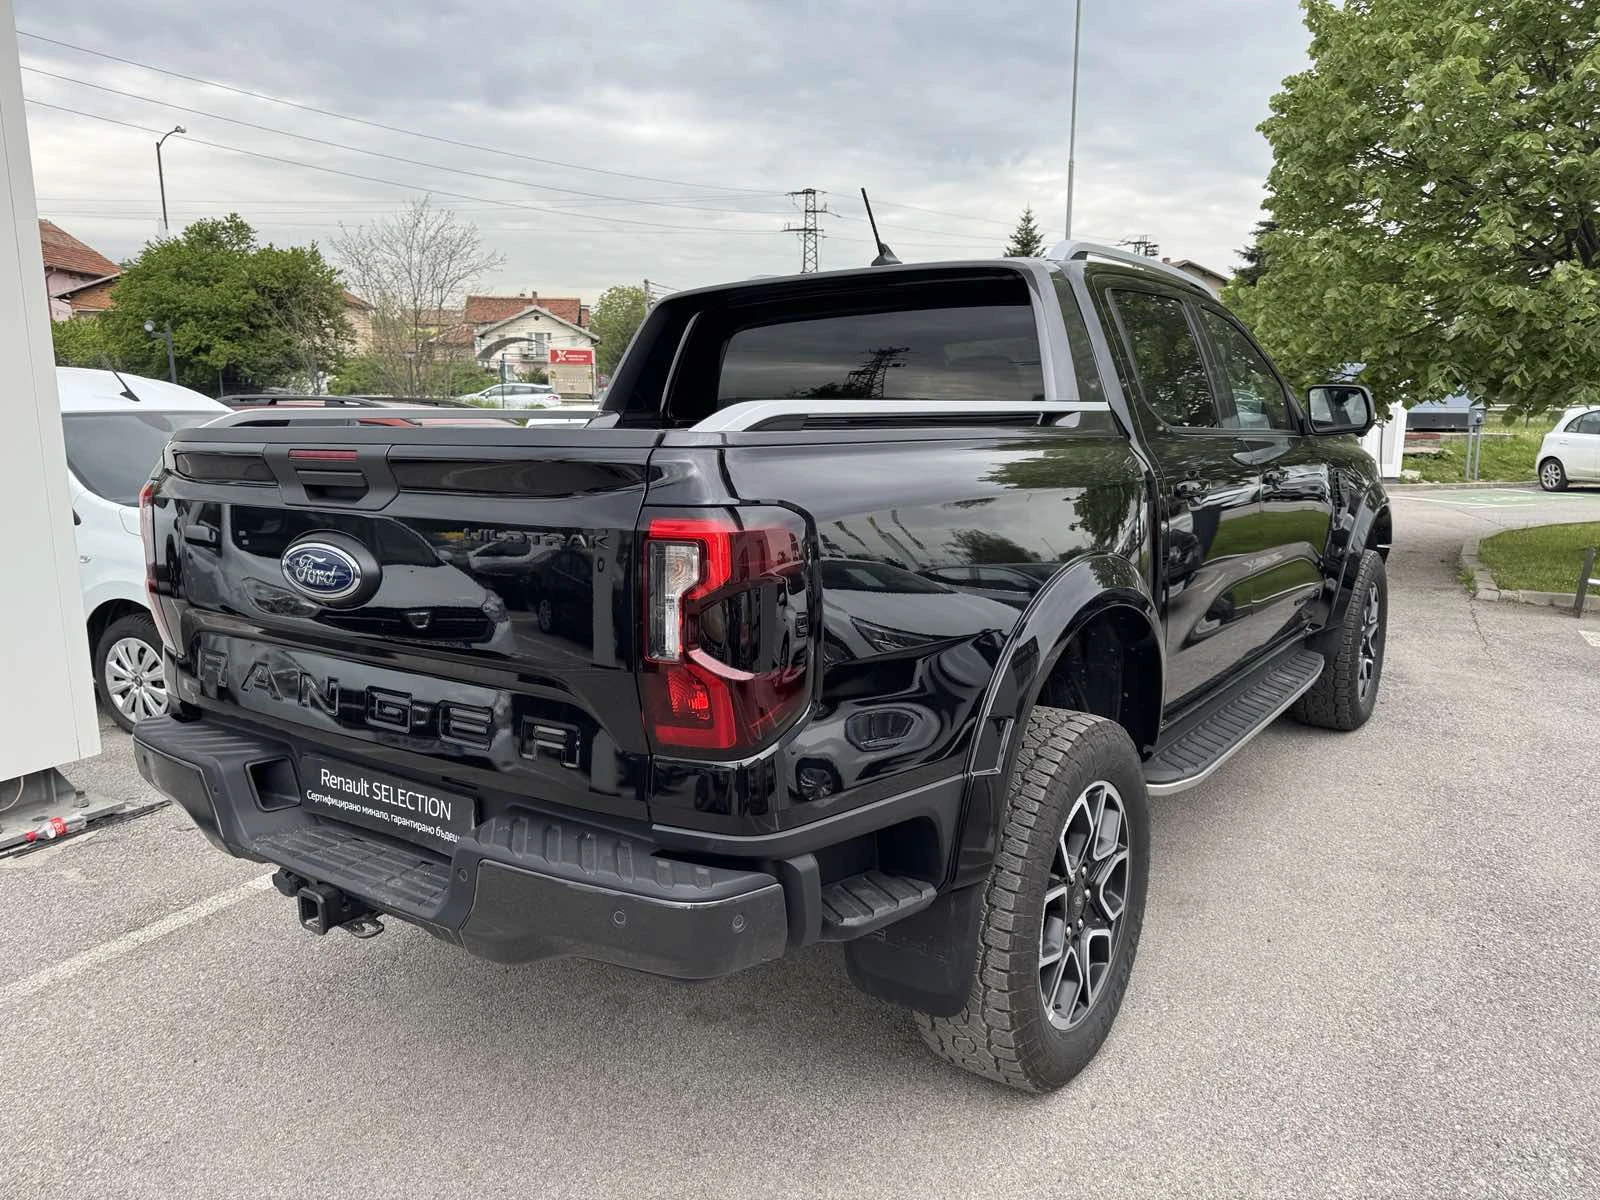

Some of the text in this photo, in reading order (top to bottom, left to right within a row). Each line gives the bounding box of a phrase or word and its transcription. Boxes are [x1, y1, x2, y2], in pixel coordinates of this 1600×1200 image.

[295, 554, 337, 586] Ford
[199, 650, 581, 769] RANGER
[306, 789, 362, 814] Сертифицирано
[362, 805, 390, 822] минало,
[390, 815, 436, 836] гарантирано
[320, 768, 452, 821] Renault SELECTION
